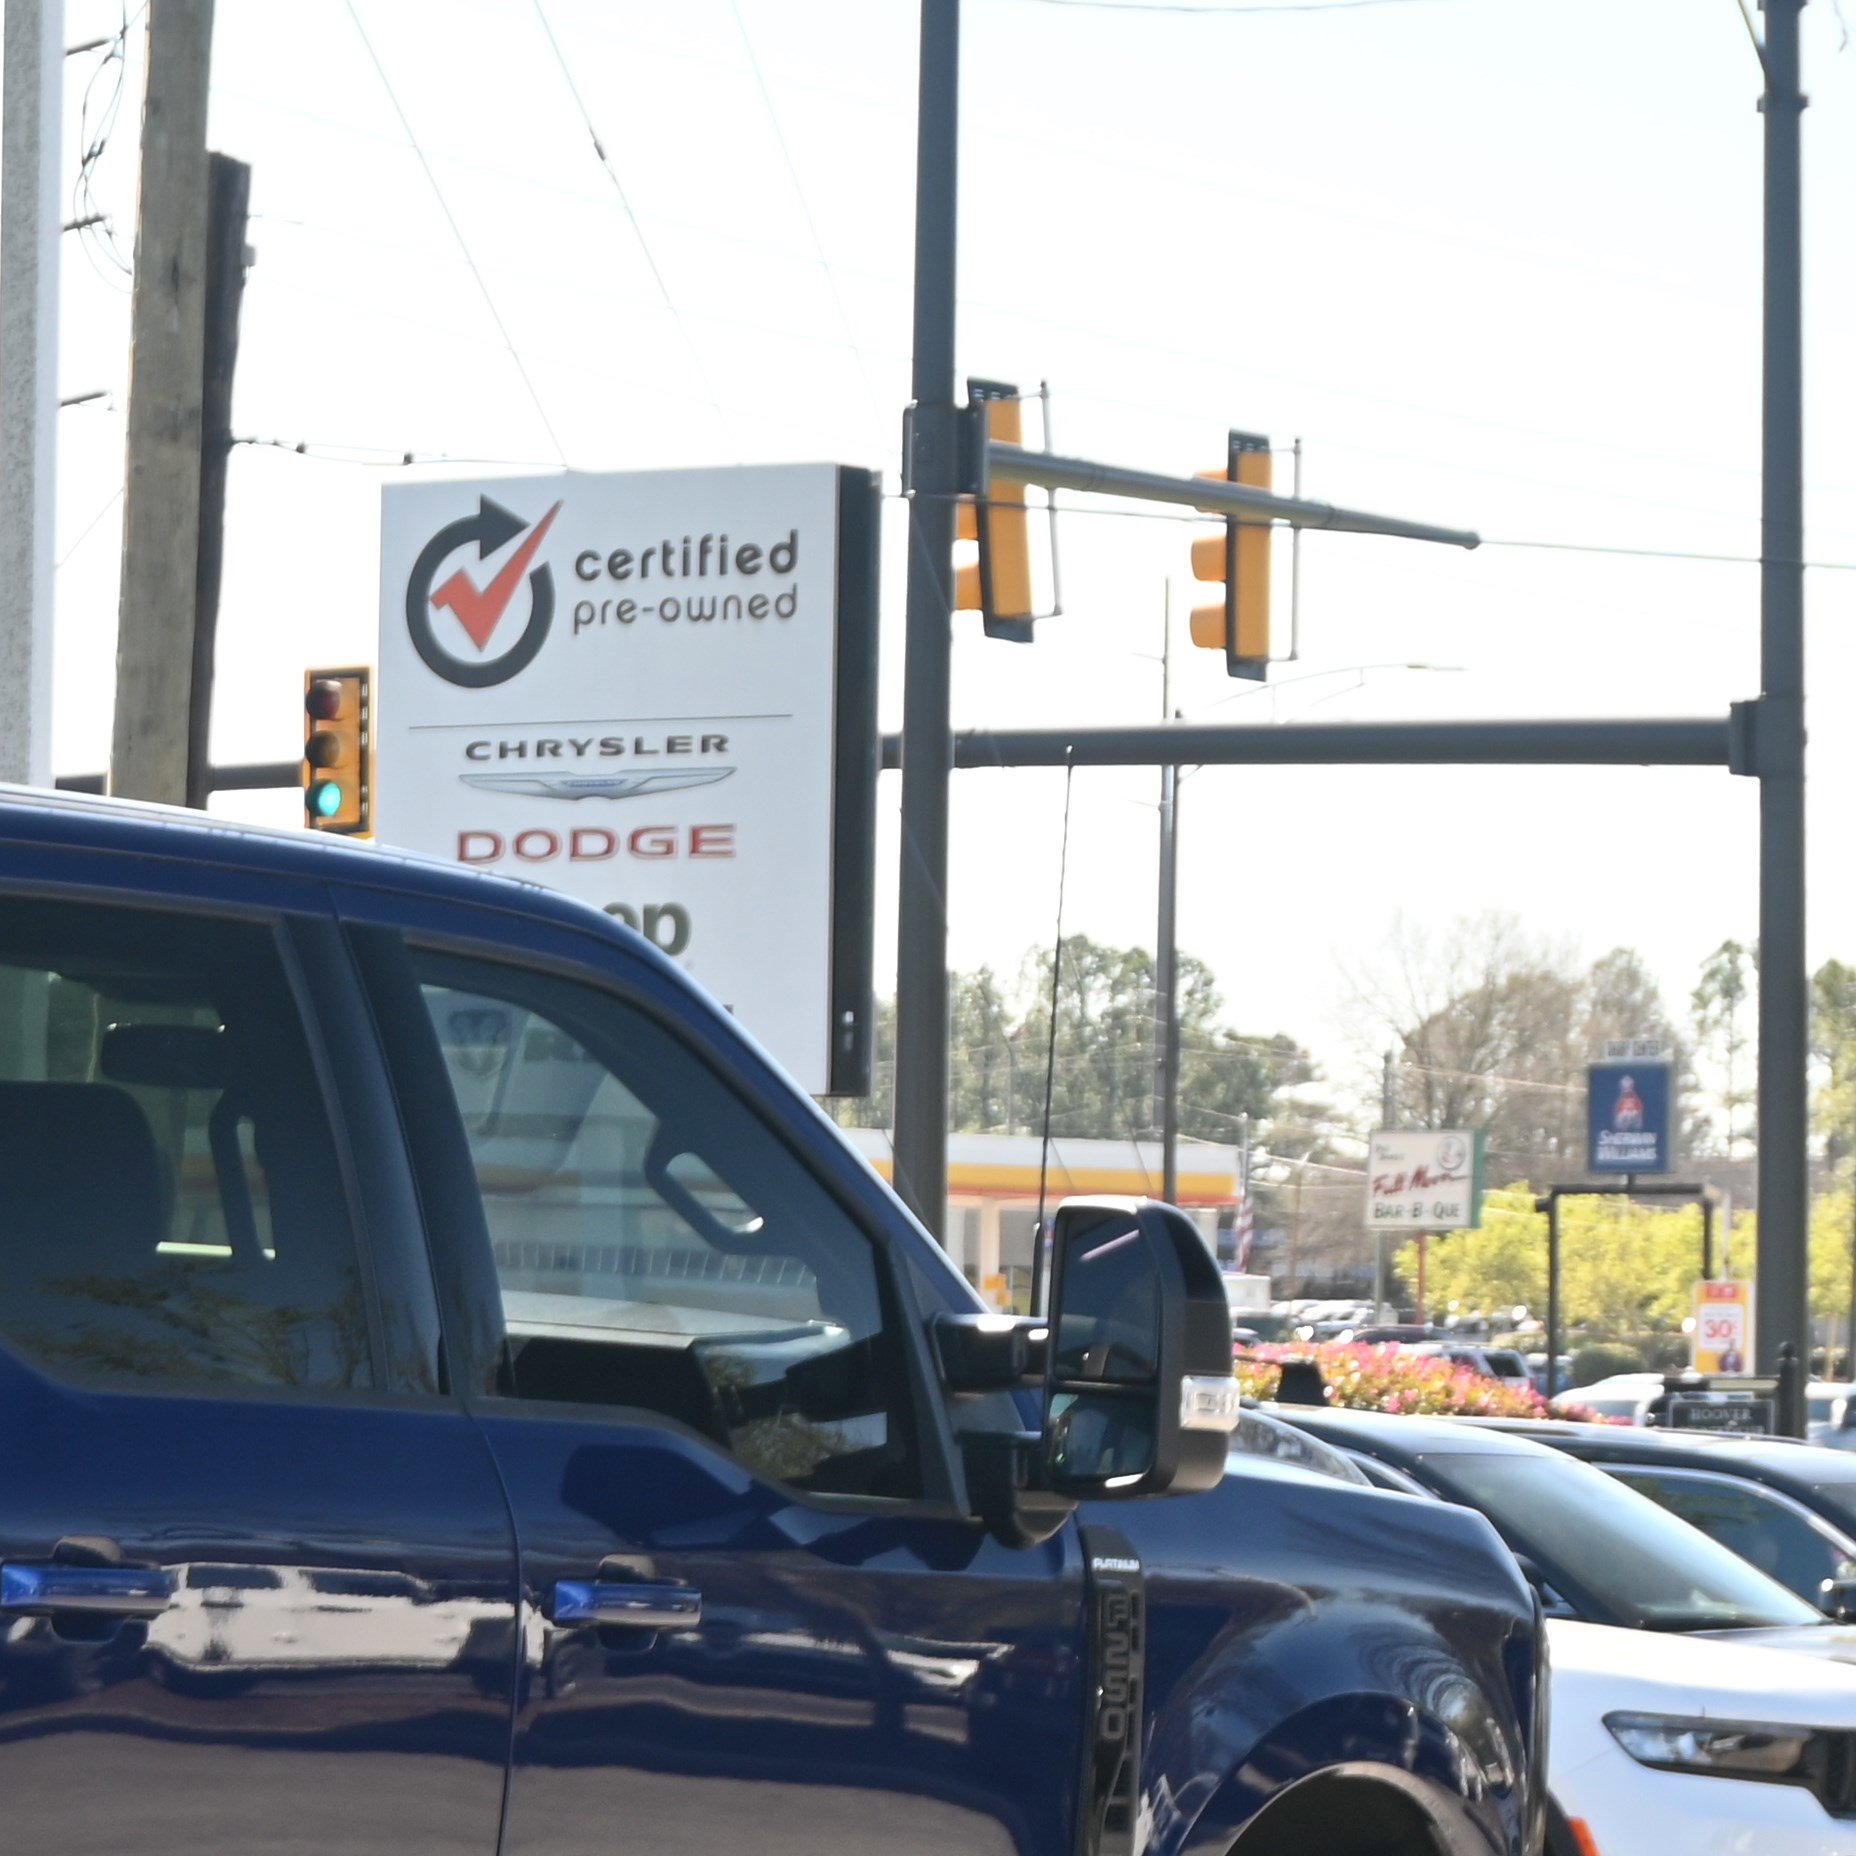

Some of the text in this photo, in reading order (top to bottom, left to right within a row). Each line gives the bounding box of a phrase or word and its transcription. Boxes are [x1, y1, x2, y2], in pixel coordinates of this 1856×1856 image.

[575, 528, 798, 581] certified
[574, 583, 797, 634] pre-owned
[466, 735, 730, 760] CHRYSLER
[456, 823, 737, 865] DODGE
